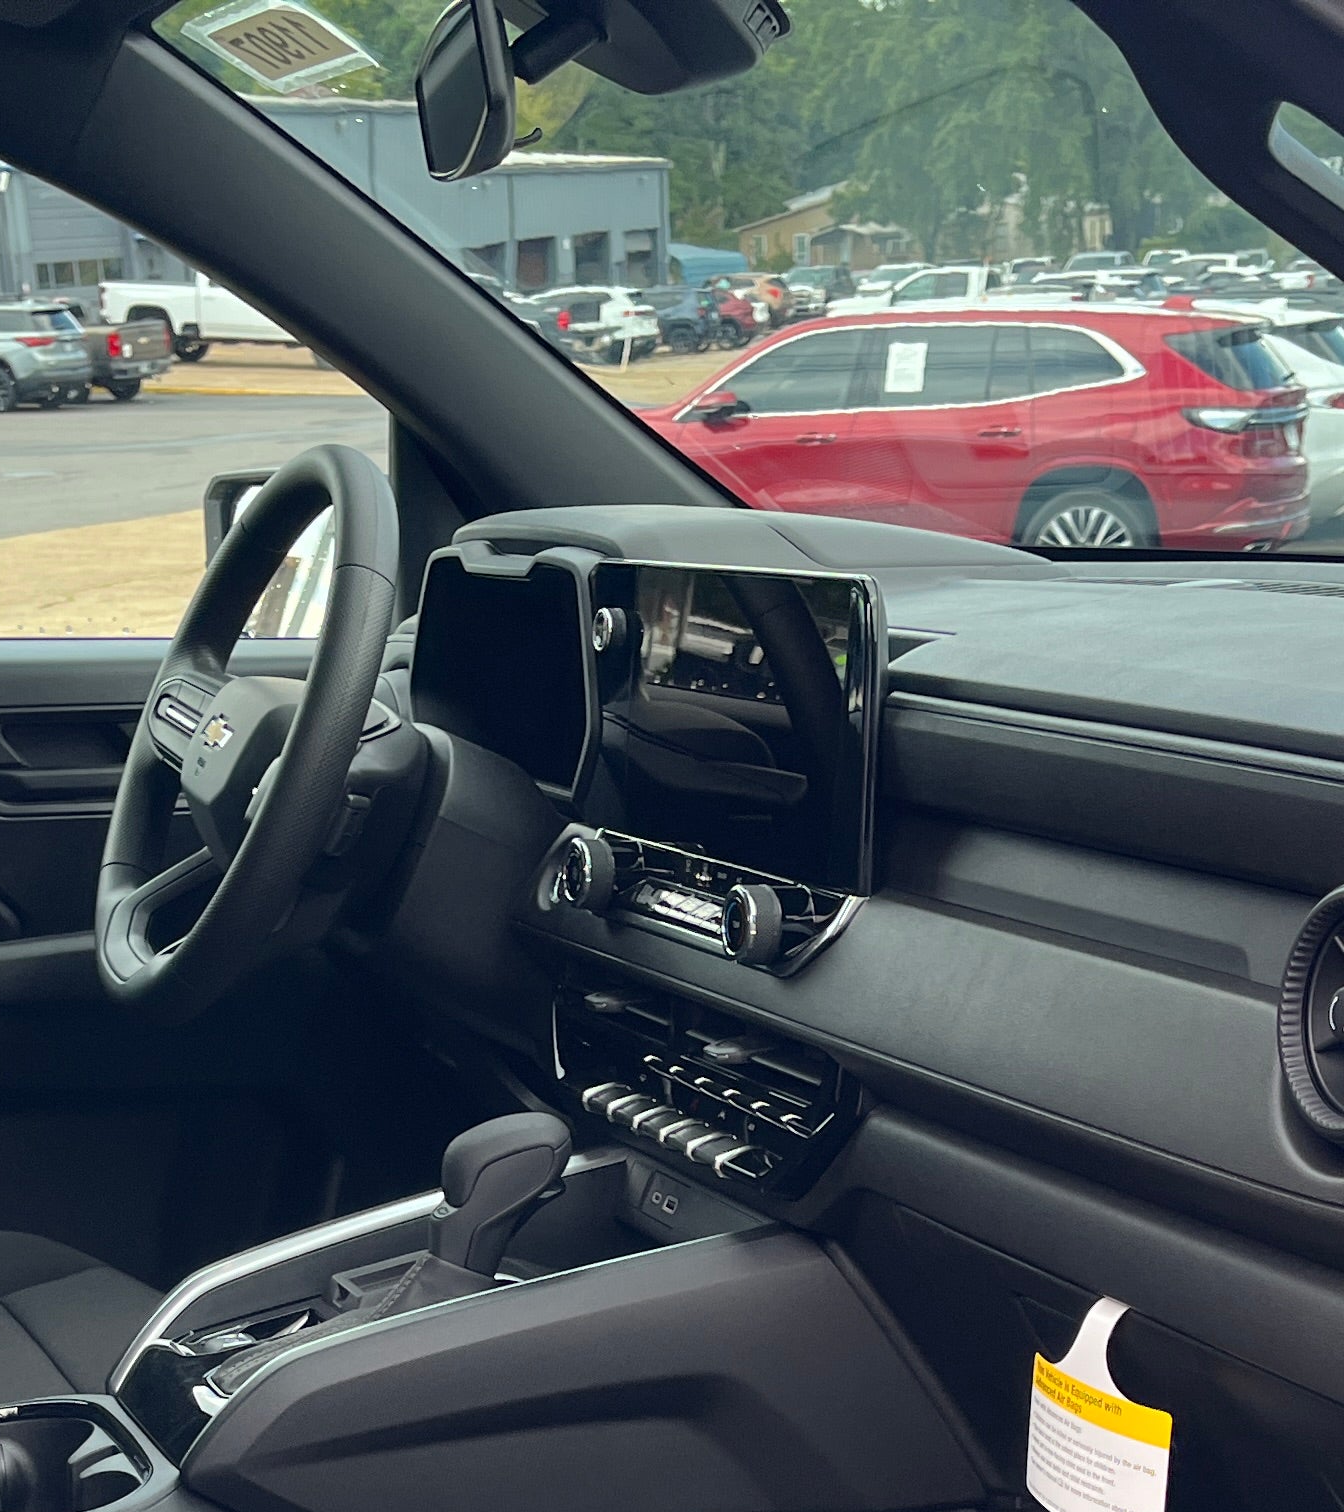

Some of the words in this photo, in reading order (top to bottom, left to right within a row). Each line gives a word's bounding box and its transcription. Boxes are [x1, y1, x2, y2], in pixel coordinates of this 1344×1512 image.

[1066, 1397, 1082, 1415] Bags
[1071, 1383, 1103, 1409] Equipped
[1104, 1400, 1122, 1416] with
